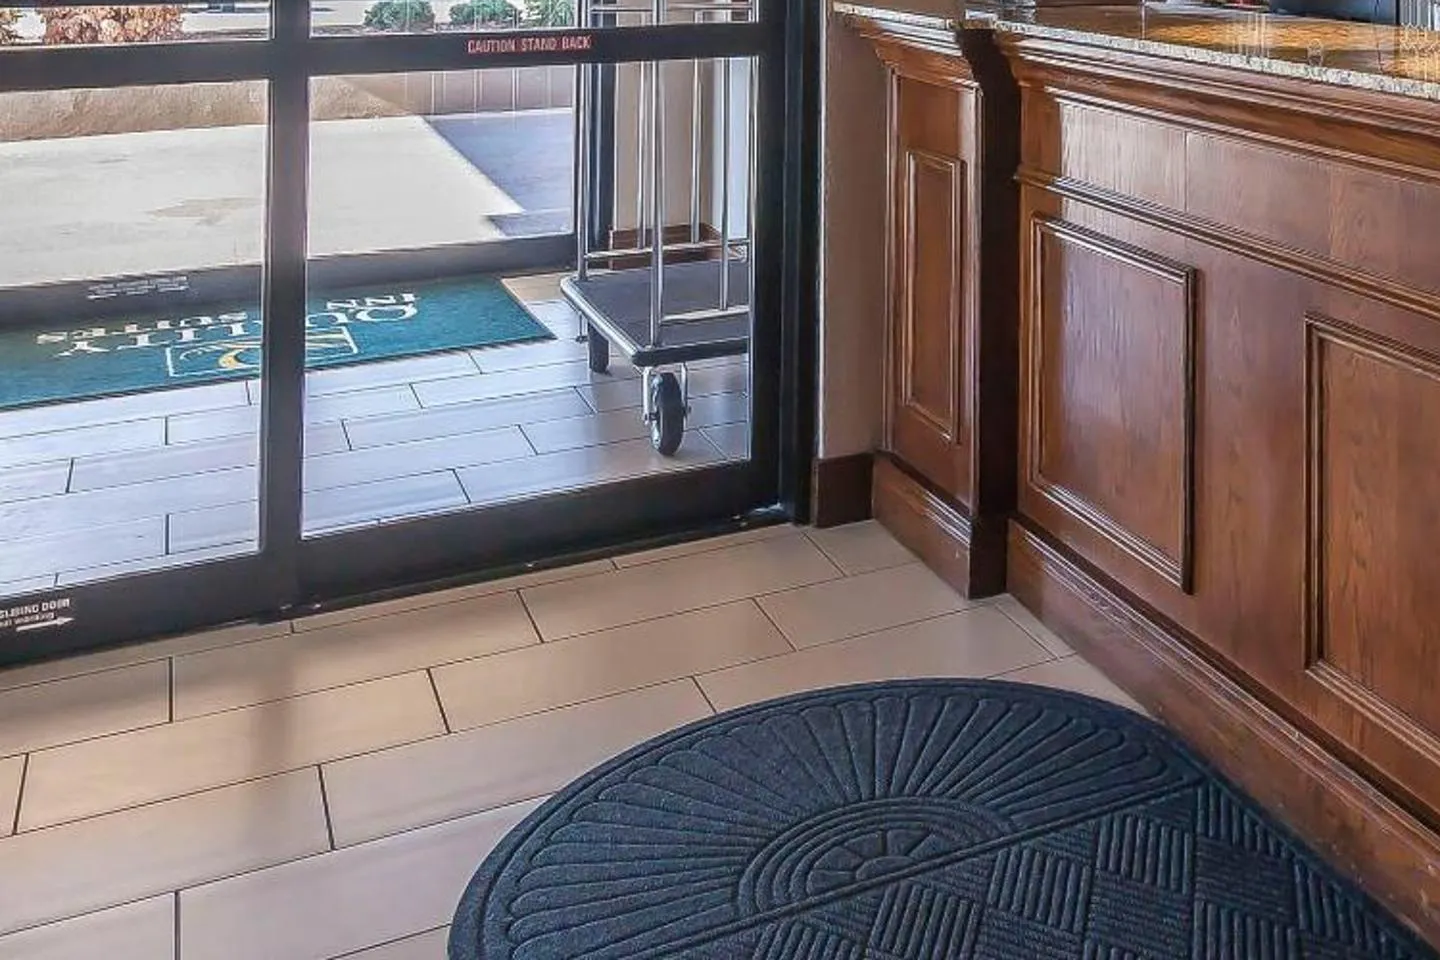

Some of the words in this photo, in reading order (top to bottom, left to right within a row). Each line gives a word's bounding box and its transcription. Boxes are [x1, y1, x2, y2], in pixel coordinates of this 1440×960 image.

[468, 39, 515, 53] CAUTION
[521, 37, 558, 52] STAND
[562, 35, 592, 50] BACK
[326, 292, 418, 310] INN
[52, 304, 418, 358] QULITY
